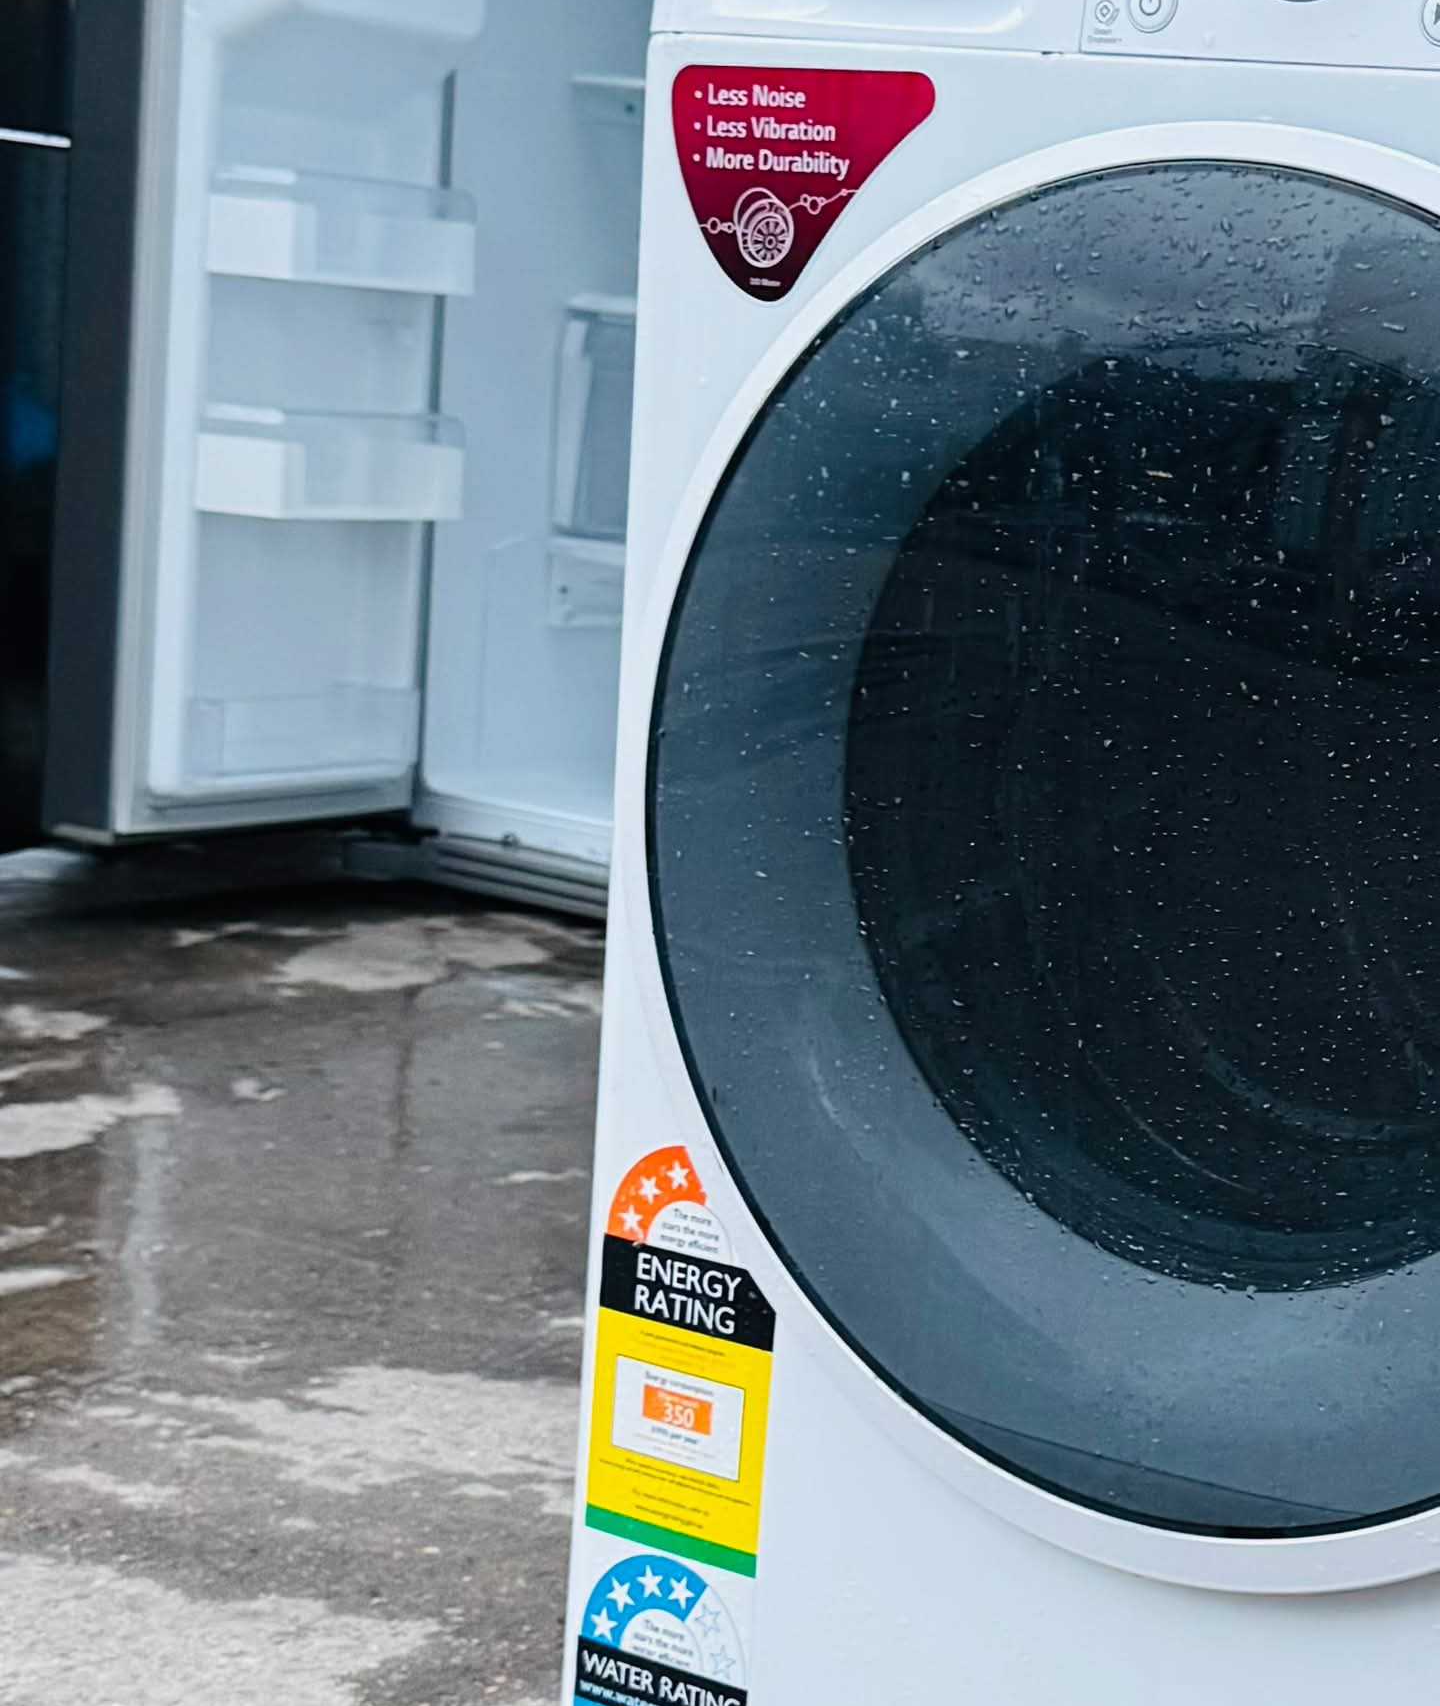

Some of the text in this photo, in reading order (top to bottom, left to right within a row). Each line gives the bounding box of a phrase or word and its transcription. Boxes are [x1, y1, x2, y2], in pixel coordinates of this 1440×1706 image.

[707, 83, 806, 109] Less Noise
[707, 115, 836, 142] Less Vibration
[706, 147, 850, 181] More Durability
[636, 1252, 742, 1302] ENERGY
[634, 1284, 736, 1335] RATING
[663, 1402, 695, 1429] 350
[582, 1649, 654, 1694] WATER
